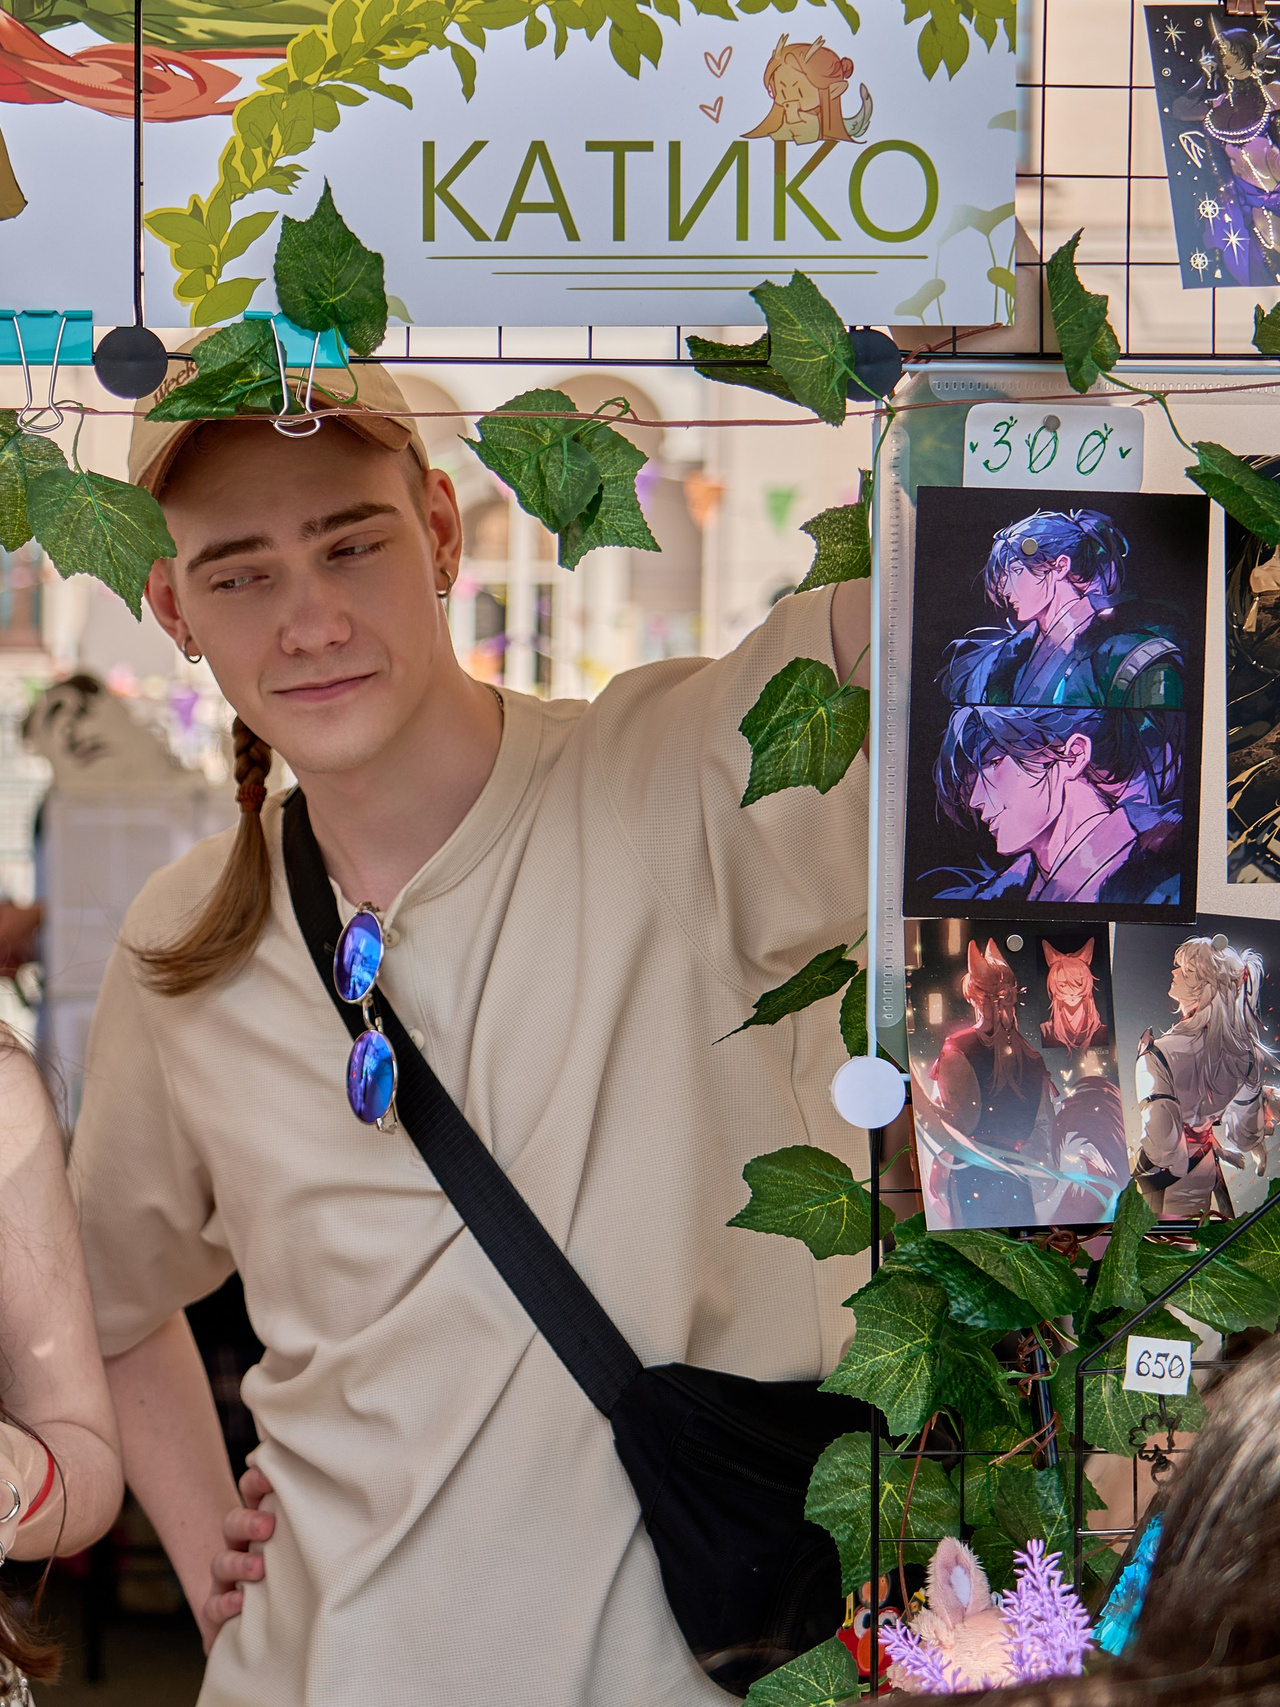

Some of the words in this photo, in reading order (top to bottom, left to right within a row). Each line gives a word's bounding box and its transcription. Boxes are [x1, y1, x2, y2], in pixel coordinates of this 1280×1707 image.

[422, 139, 939, 243] КАТИКО
[983, 416, 1114, 476] 300
[1135, 1350, 1185, 1379] 650
